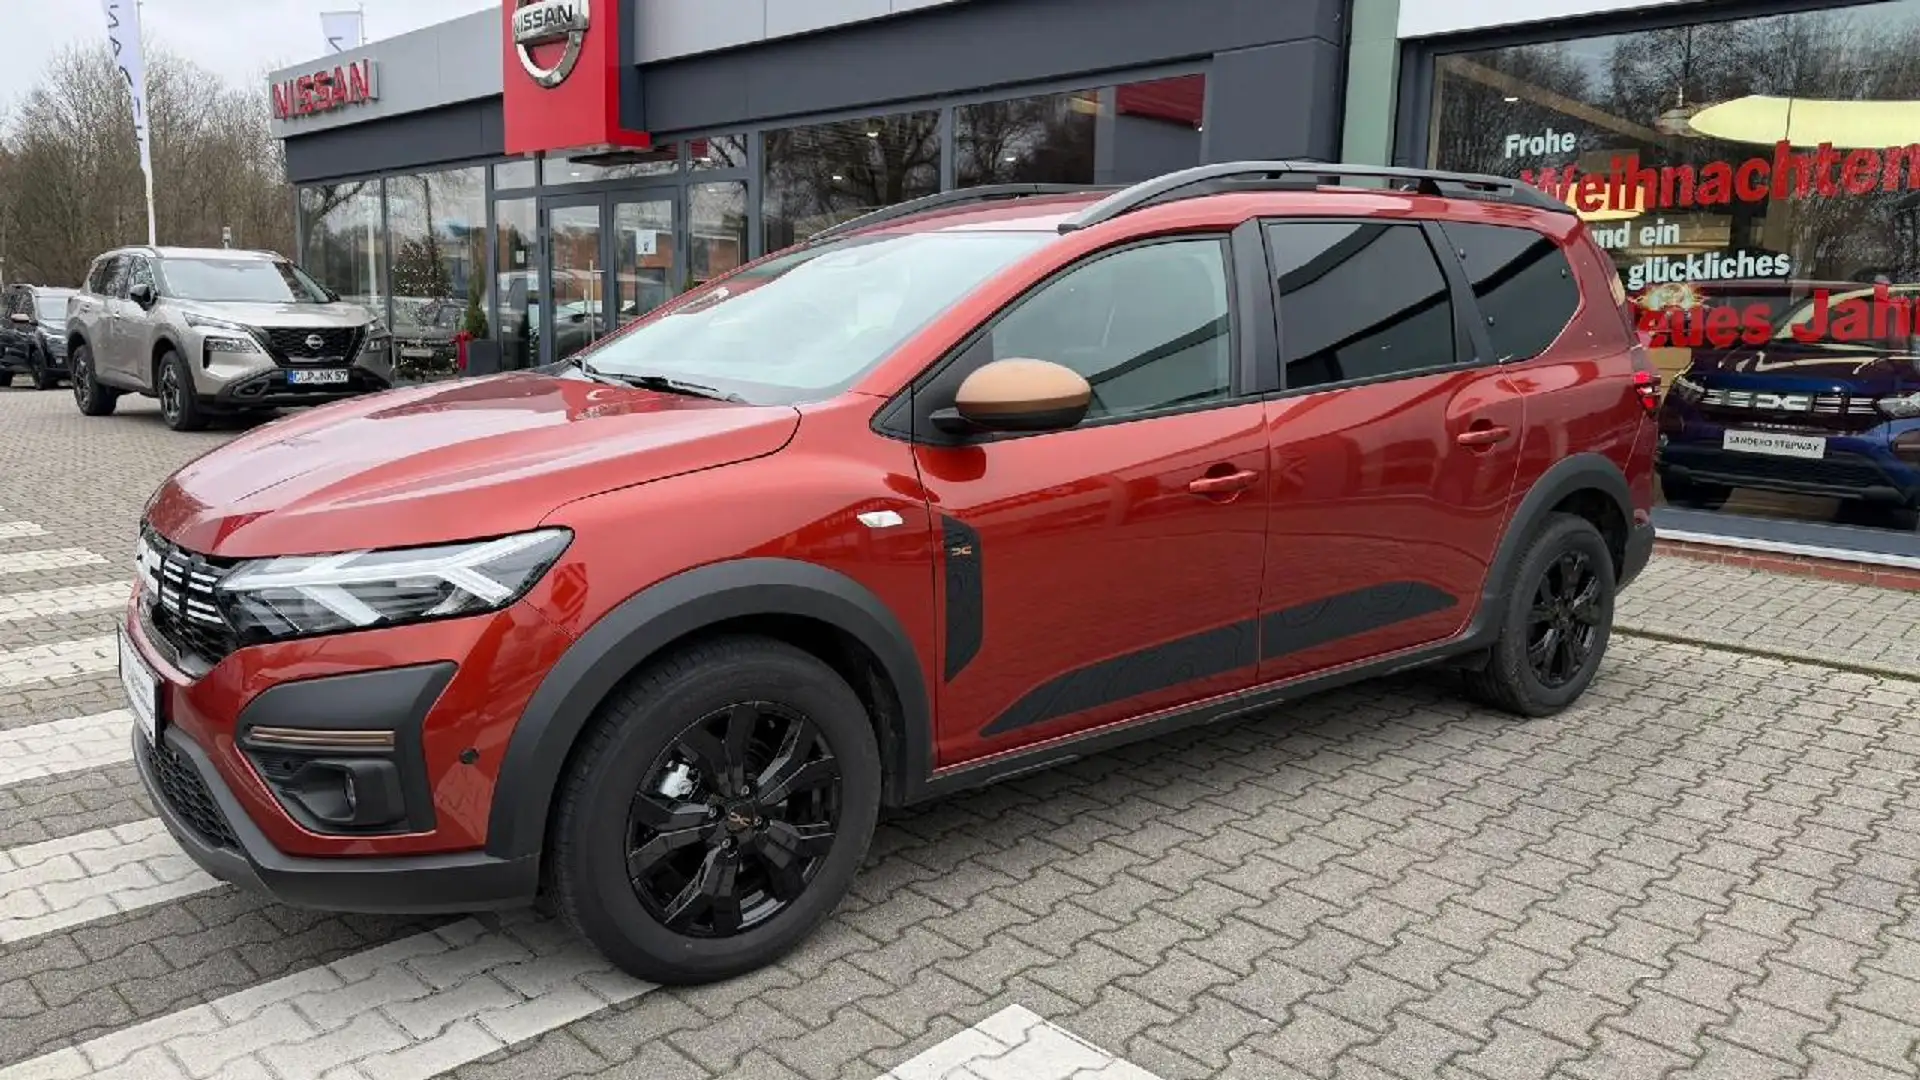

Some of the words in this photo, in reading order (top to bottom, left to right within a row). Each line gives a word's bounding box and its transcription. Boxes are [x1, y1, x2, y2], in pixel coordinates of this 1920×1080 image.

[515, 4, 573, 34] NISSAN
[271, 58, 371, 121] NISSAN
[1505, 128, 1577, 158] Frohe
[1640, 218, 1680, 246] ein
[1627, 250, 1790, 290] glückliches
[1630, 300, 1773, 349] eues
